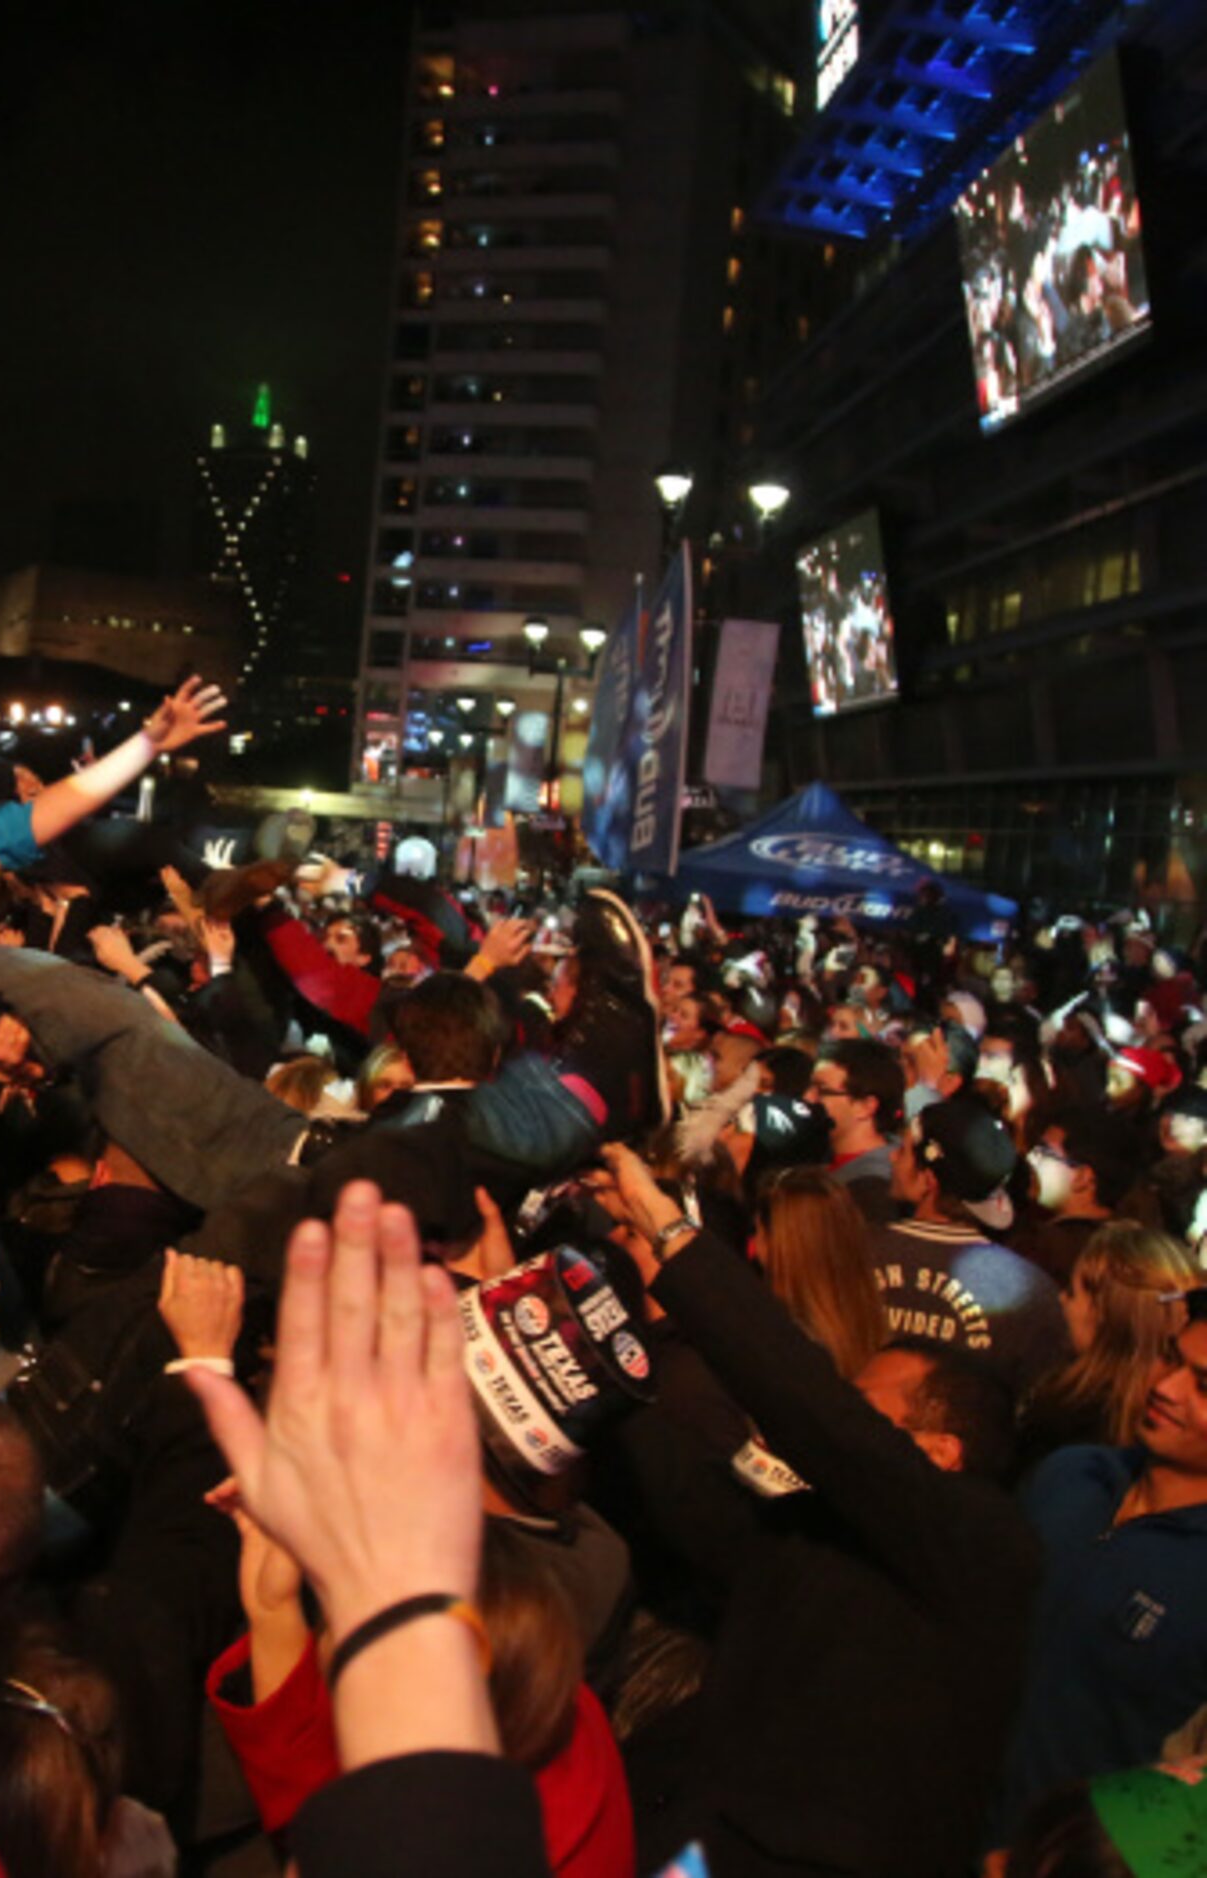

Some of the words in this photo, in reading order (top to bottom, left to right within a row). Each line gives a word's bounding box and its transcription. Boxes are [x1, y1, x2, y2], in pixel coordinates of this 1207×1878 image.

[887, 1306, 957, 1341] VIDED
[917, 1267, 992, 1349] STREETS
[530, 1330, 599, 1402] TEXAS
[490, 1374, 530, 1424] TEXAS
